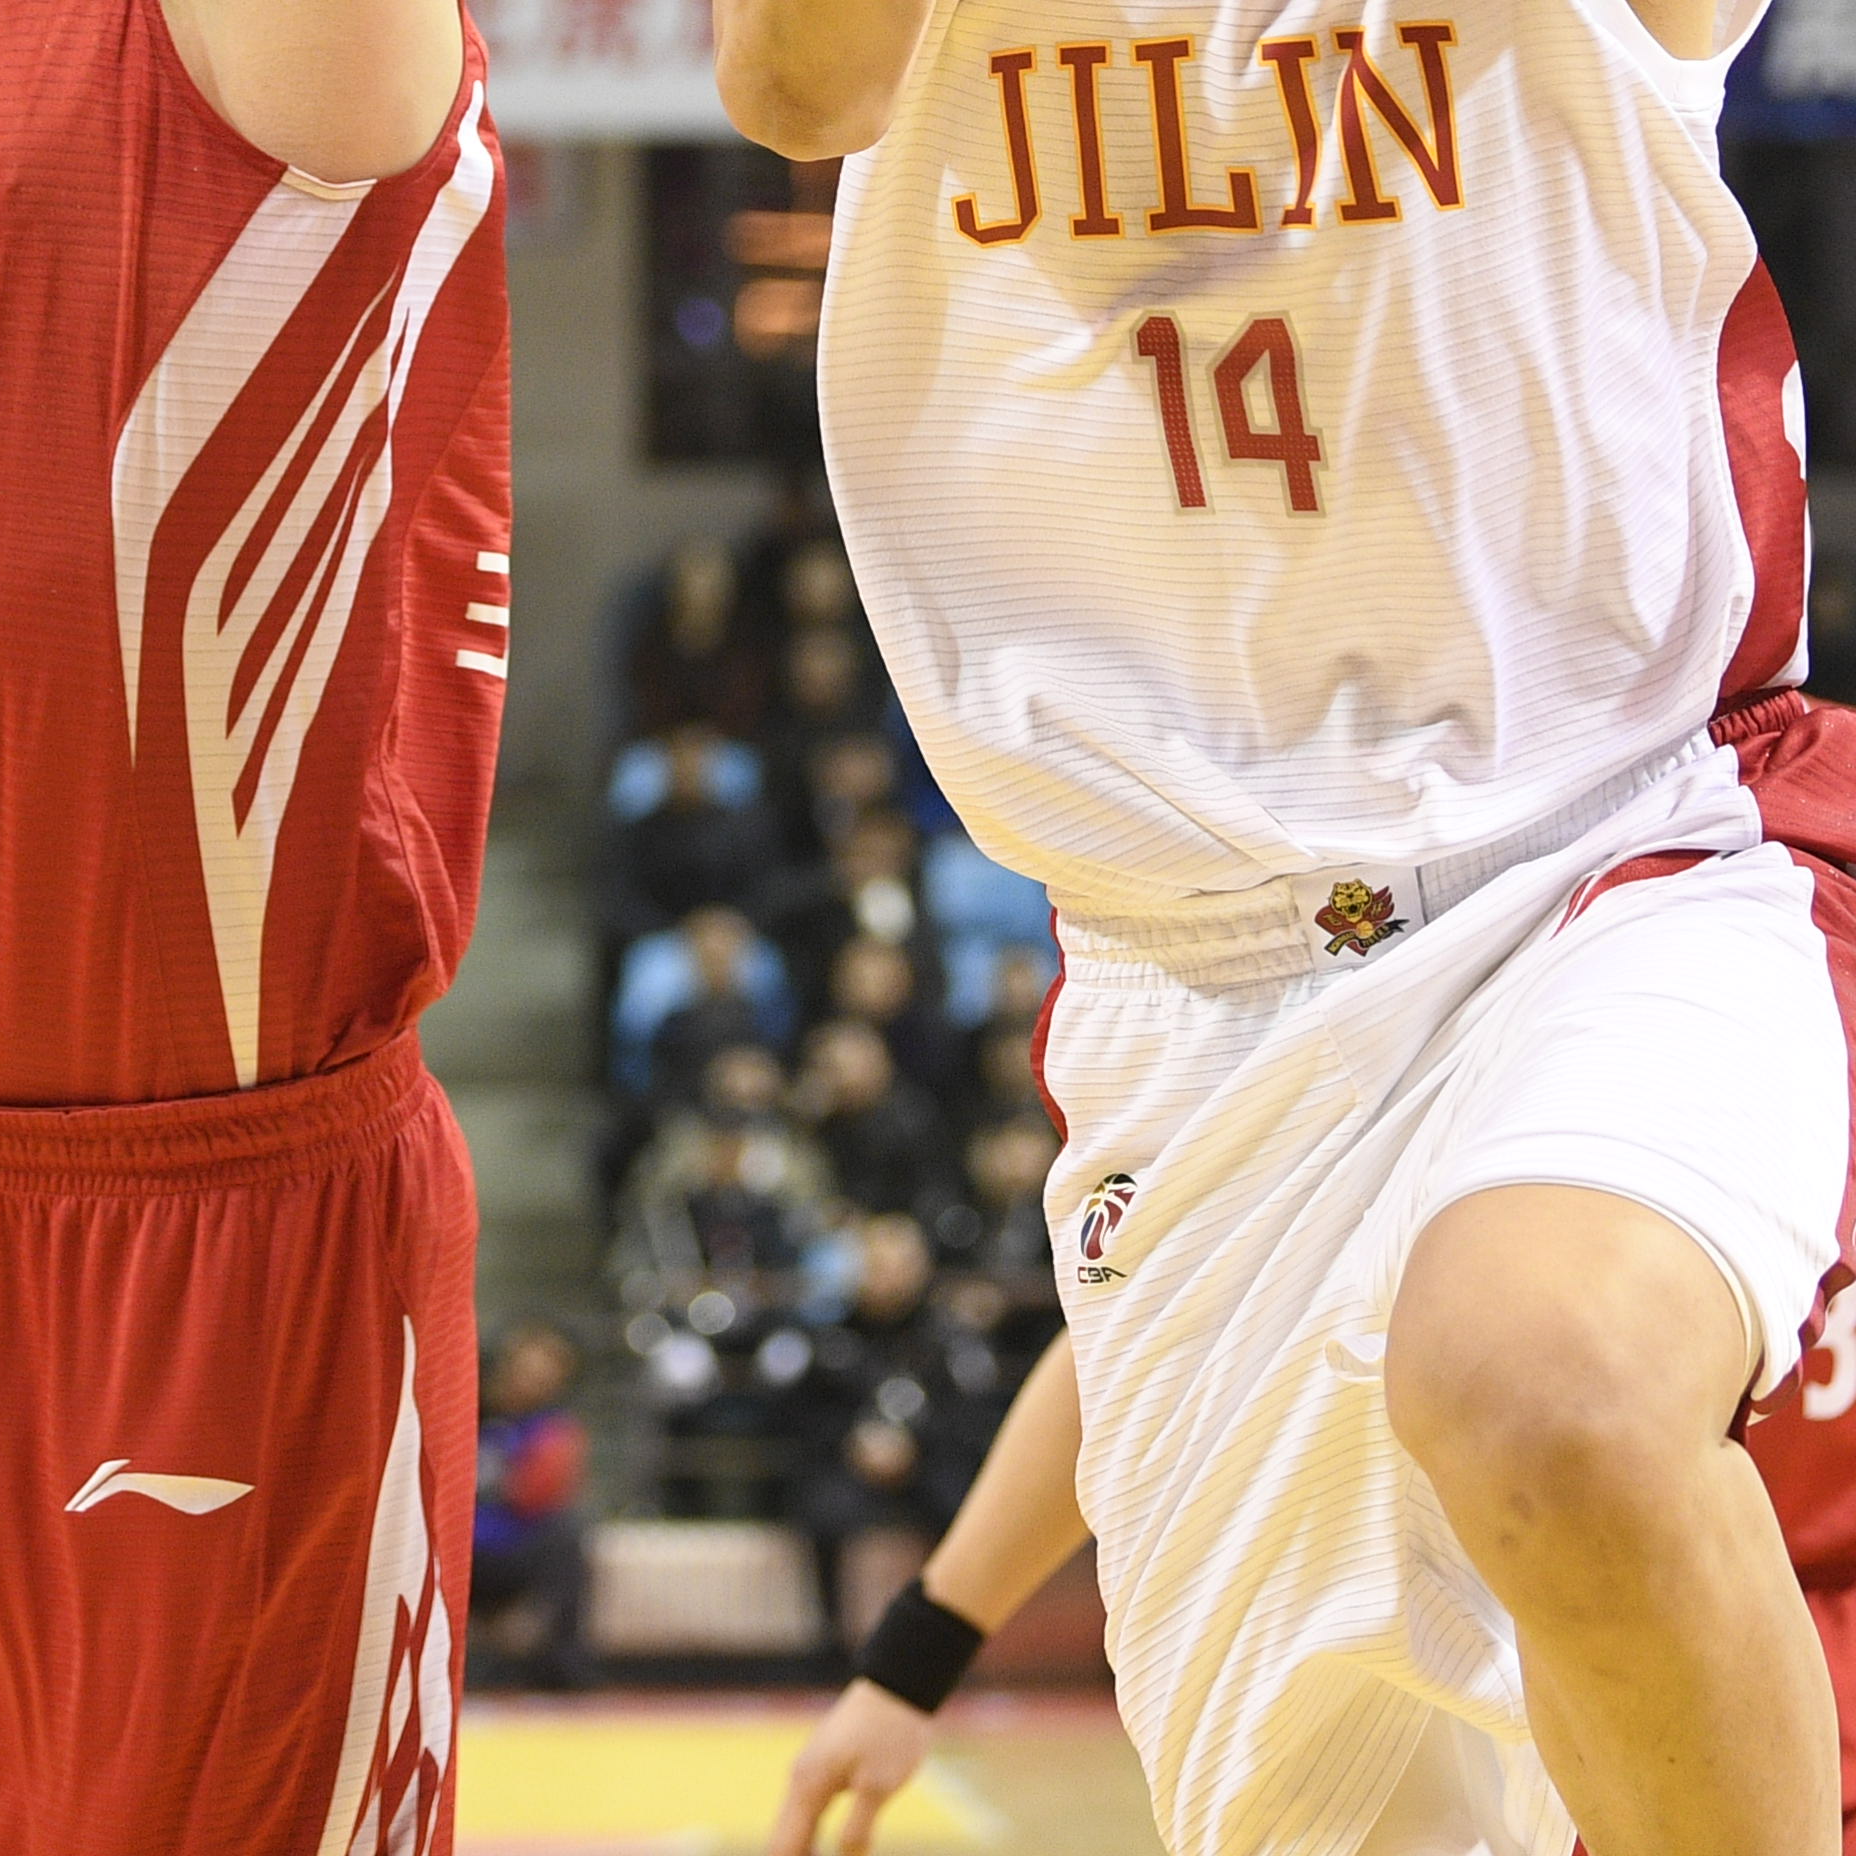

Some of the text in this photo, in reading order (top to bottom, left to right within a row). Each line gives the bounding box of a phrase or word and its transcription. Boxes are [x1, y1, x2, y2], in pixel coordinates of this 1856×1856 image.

[951, 19, 1465, 248] JILIN
[1130, 310, 1328, 518] 14
[1077, 1266, 1127, 1284] CBA
